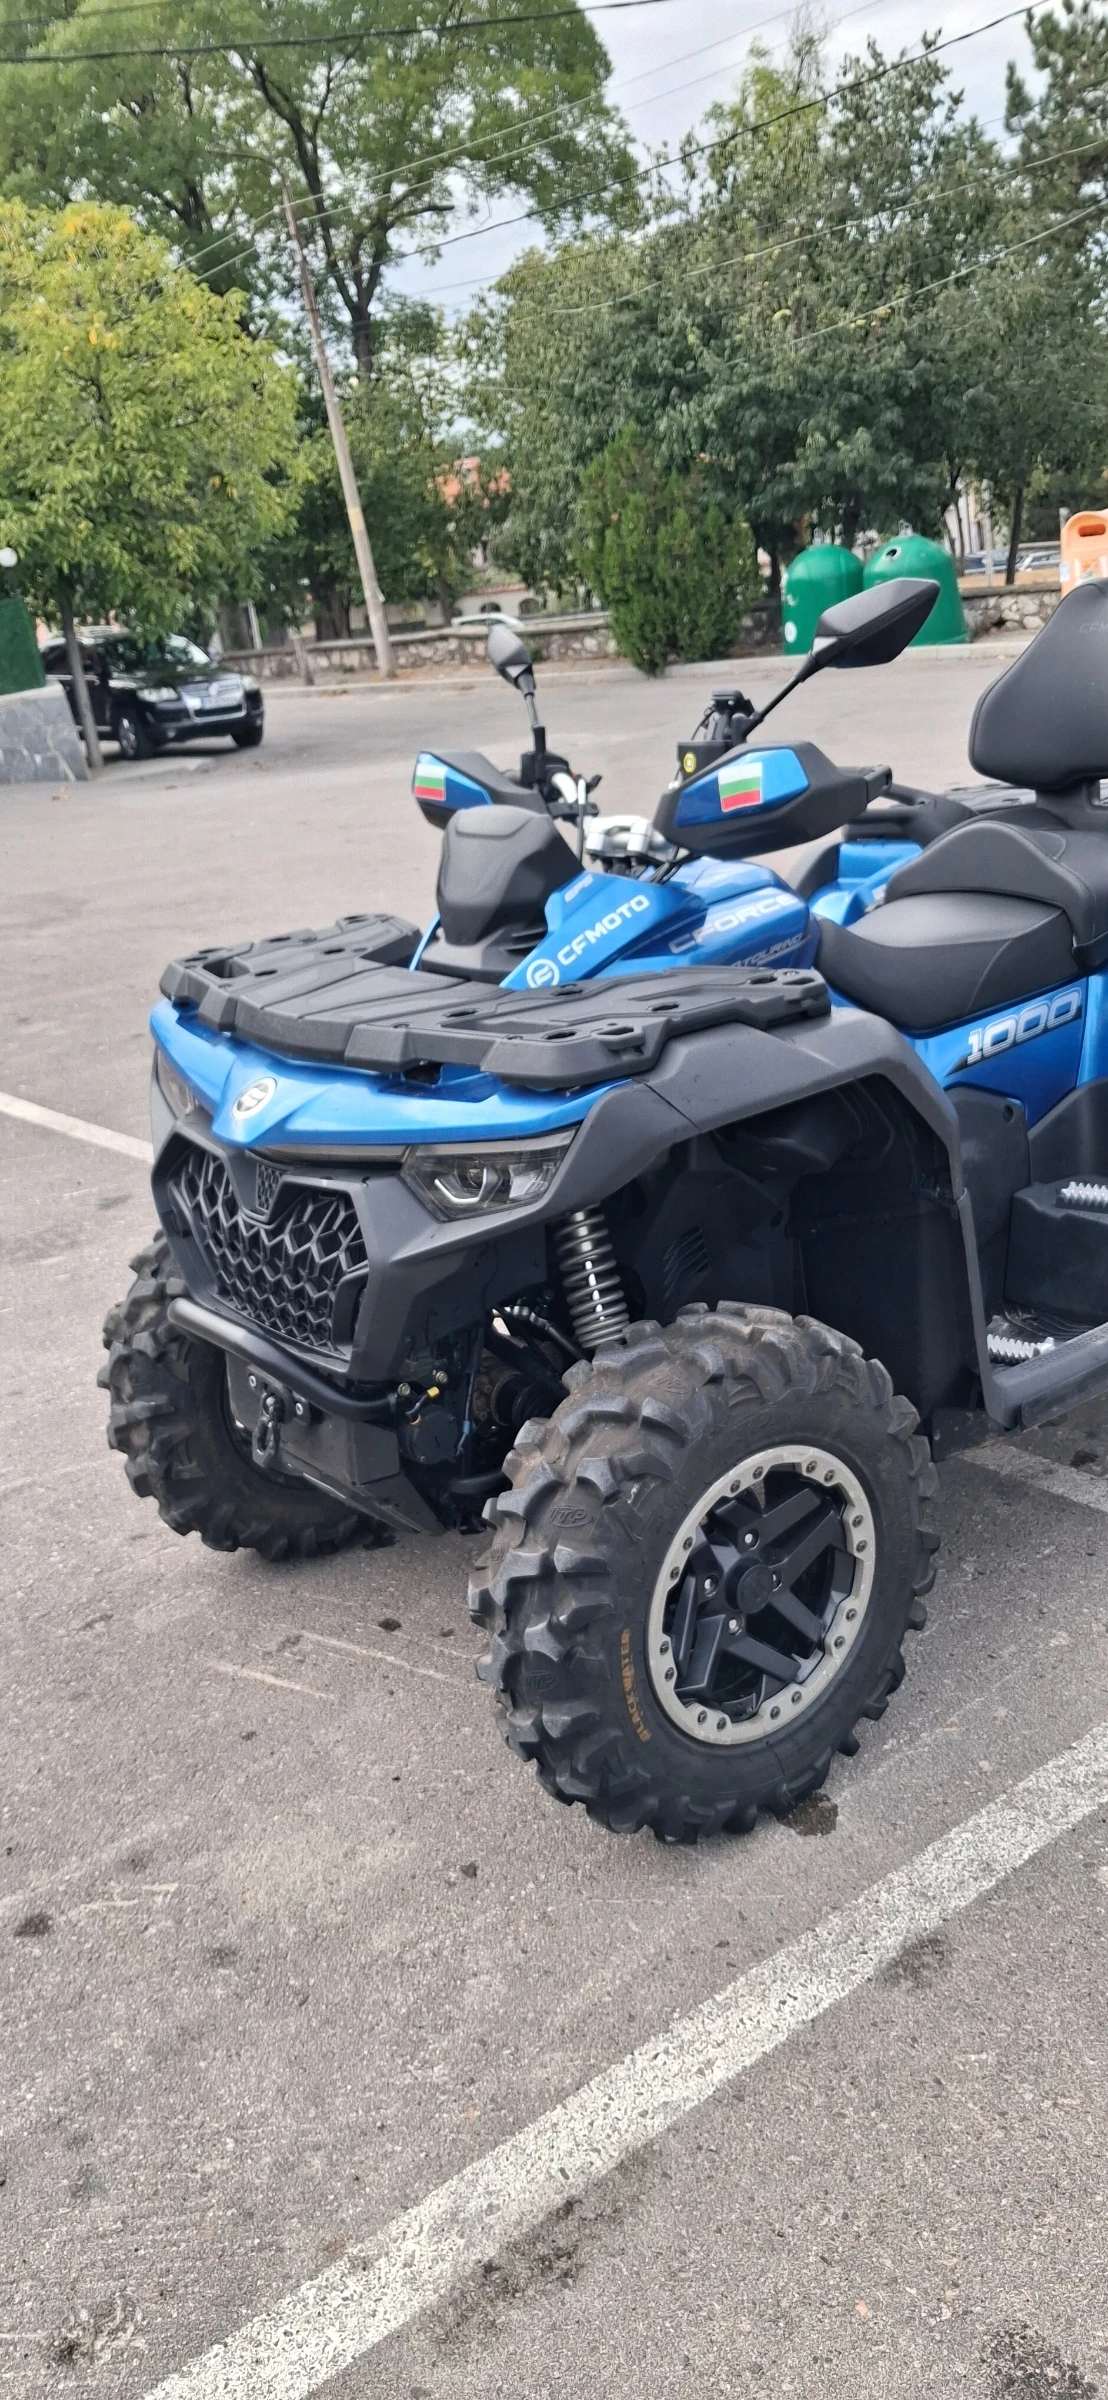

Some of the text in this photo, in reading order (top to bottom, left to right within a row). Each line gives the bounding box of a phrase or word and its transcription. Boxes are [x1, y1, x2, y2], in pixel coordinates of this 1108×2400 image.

[557, 894, 650, 966] CFMOTO
[668, 893, 798, 955] CFORCE
[967, 987, 1082, 1065] 1000
[550, 1507, 587, 1524] ITP
[621, 1627, 652, 1743] BLACKWATER
